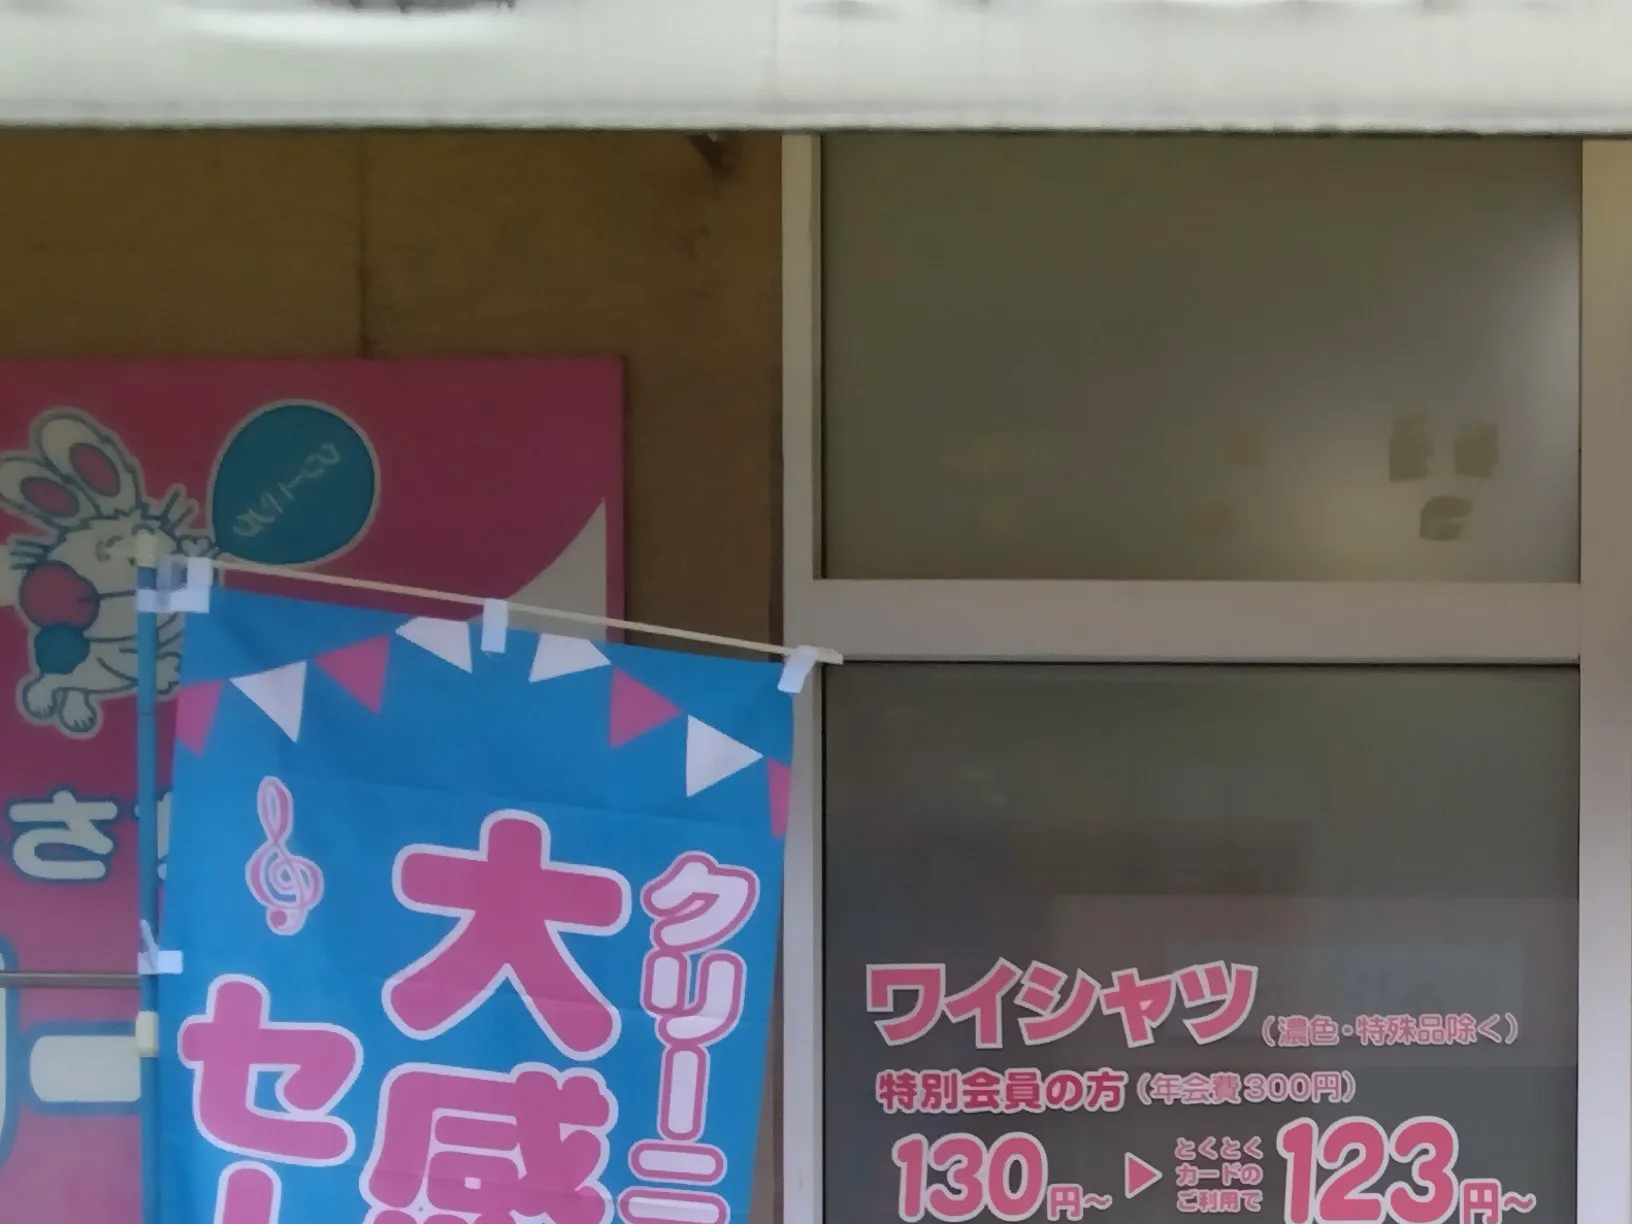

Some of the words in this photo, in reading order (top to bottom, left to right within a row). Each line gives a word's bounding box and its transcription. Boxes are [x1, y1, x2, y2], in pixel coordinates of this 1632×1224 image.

[867, 958, 1258, 1049] ワイシャツ
[876, 1067, 1125, 1114] 特別会員の方
[1174, 1136, 1264, 1160] とくとく
[1175, 1162, 1263, 1186] カードの
[1176, 1188, 1263, 1213] ご利用で
